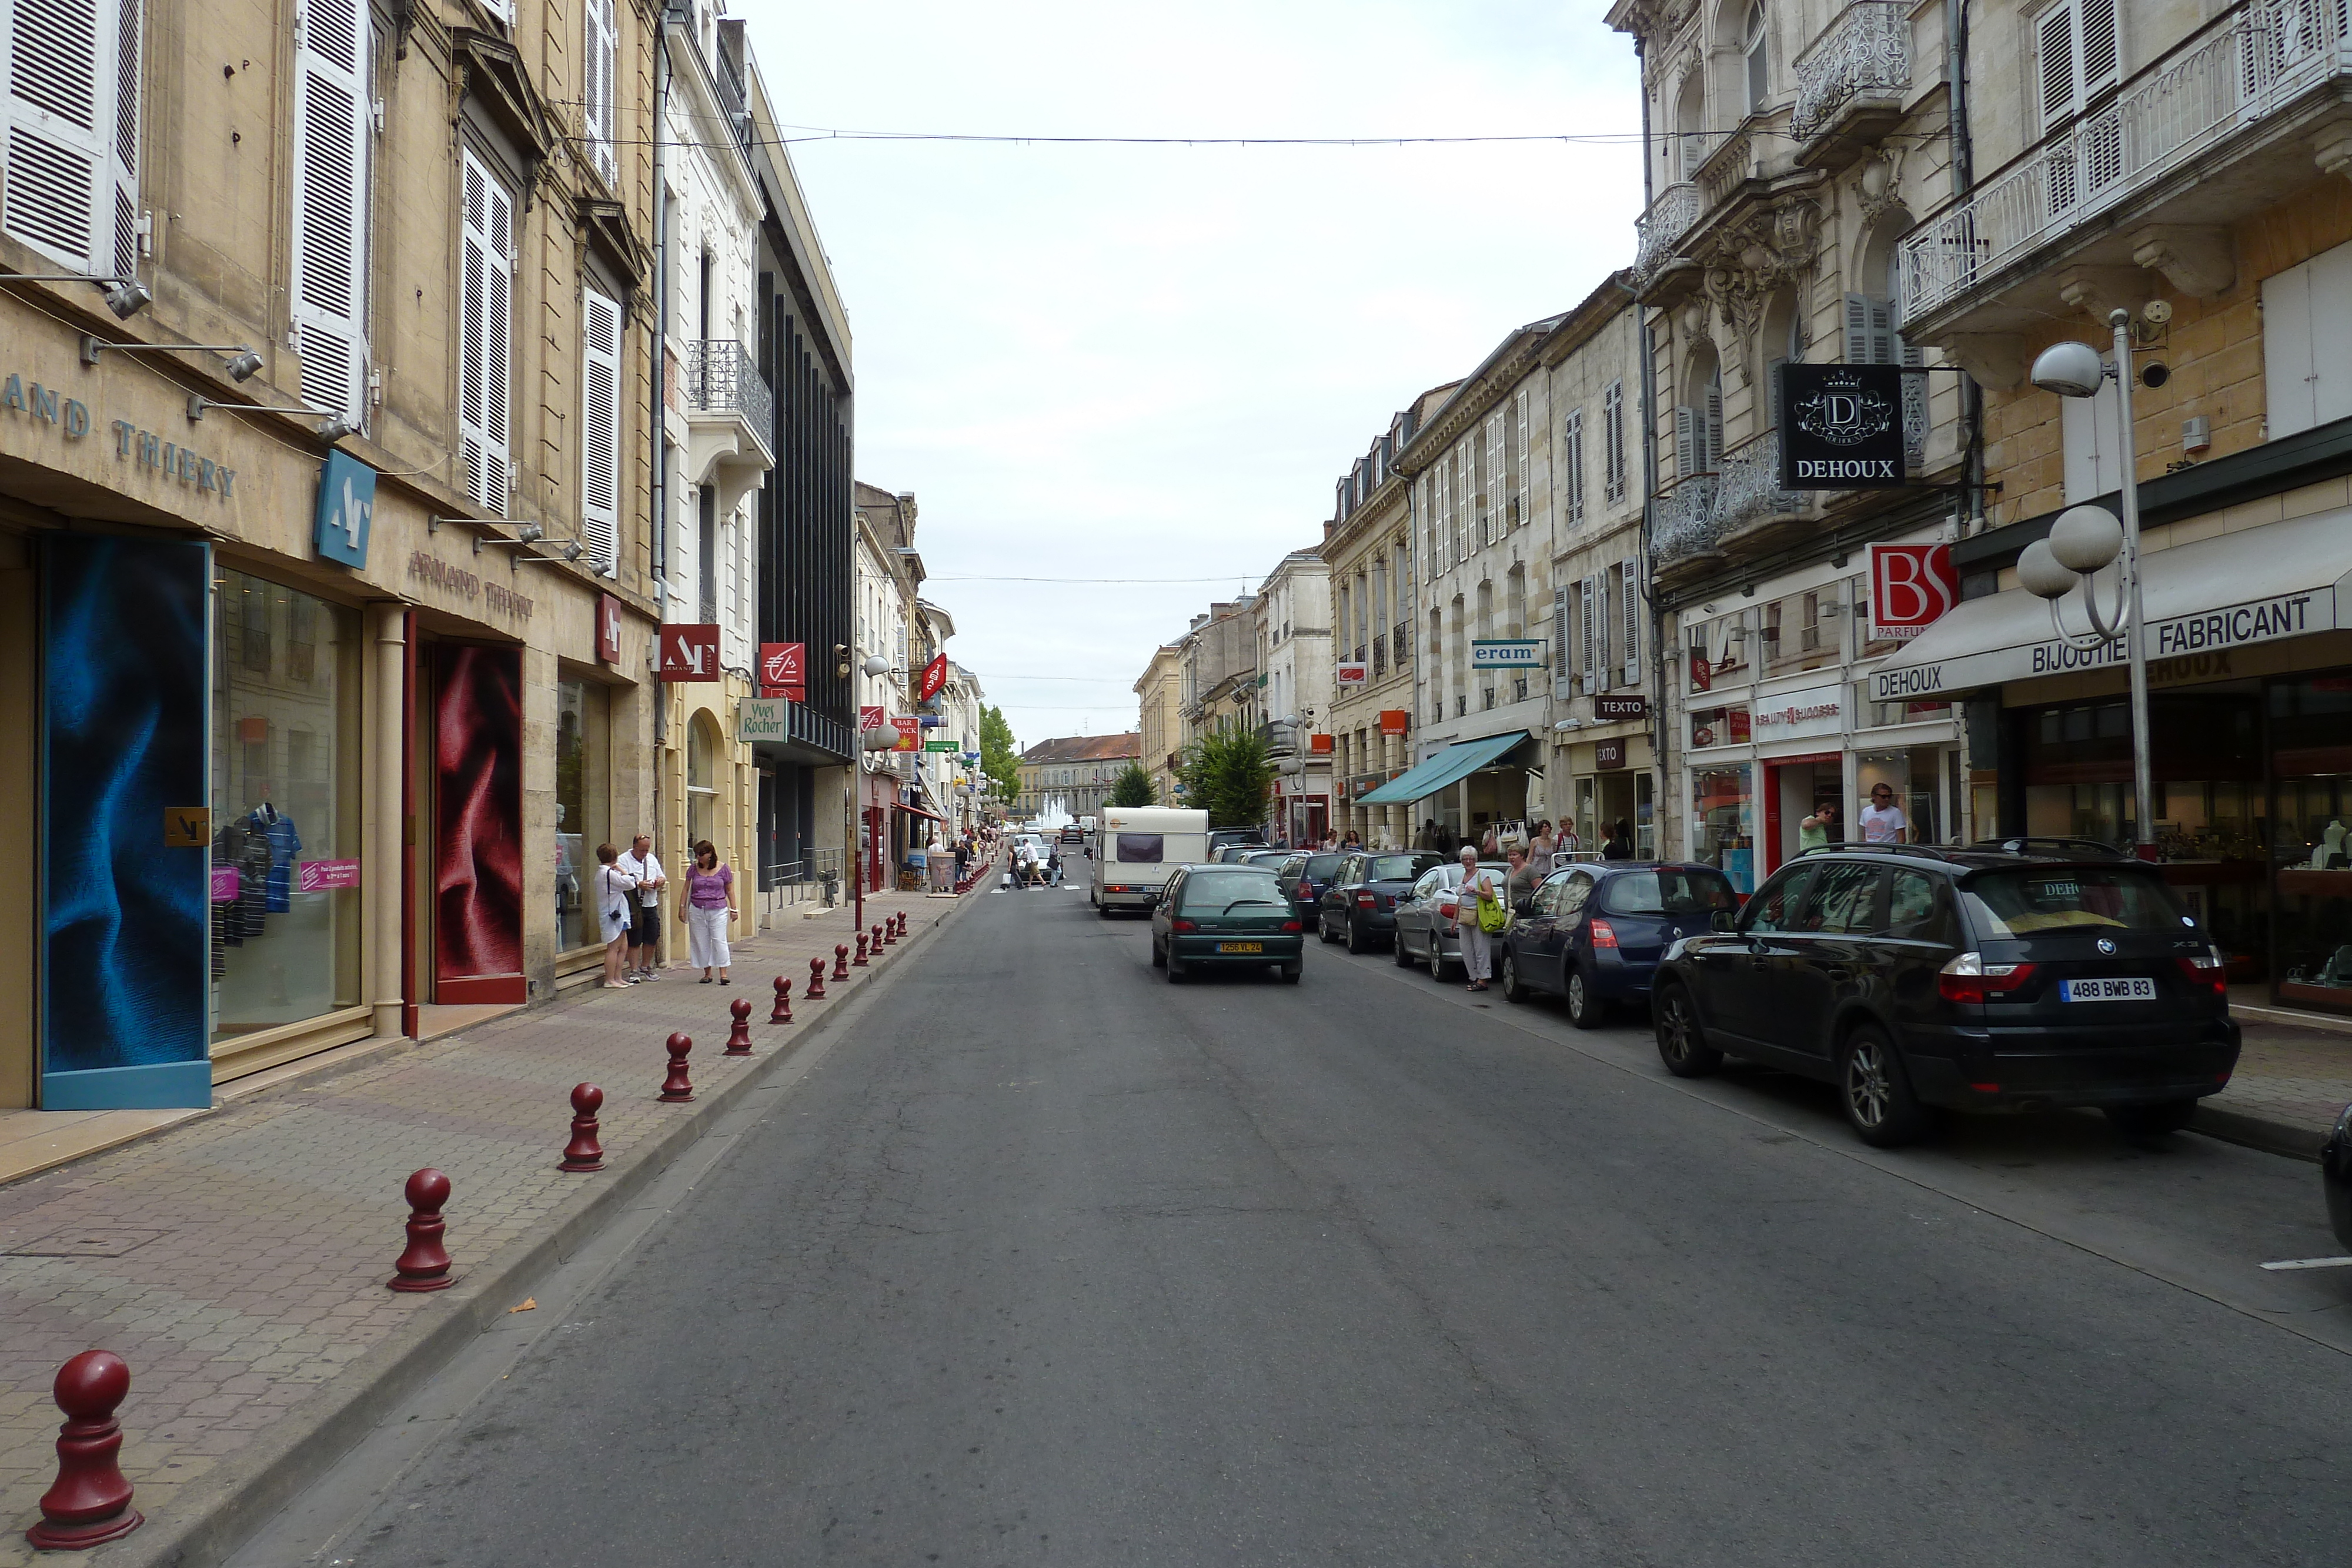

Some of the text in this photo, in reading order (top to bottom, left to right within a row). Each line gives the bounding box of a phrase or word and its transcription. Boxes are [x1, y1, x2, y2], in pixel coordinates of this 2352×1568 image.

[1829, 396, 1855, 424] D
[115, 419, 238, 498] THIERY
[1796, 460, 1895, 478] DEHOUX
[409, 550, 534, 618] ARMAND THIERY
[2032, 596, 2311, 673] BIJOUTIE FABRICANT
[1475, 646, 1532, 660] eram
[926, 663, 942, 690] TABAC
[1879, 665, 1943, 697] DEHOUX
[751, 703, 775, 718] Yves
[1602, 701, 1642, 713] TEXTO
[1755, 711, 1788, 726] BEAUTY
[1795, 703, 1839, 720] SUCCESS
[743, 716, 783, 735] Rocher
[1597, 747, 1616, 761] TEXTO
[2044, 883, 2080, 895] DEH
[1221, 943, 1260, 951] 1256 VL 24
[2072, 979, 2150, 998] 488 BWB 83
